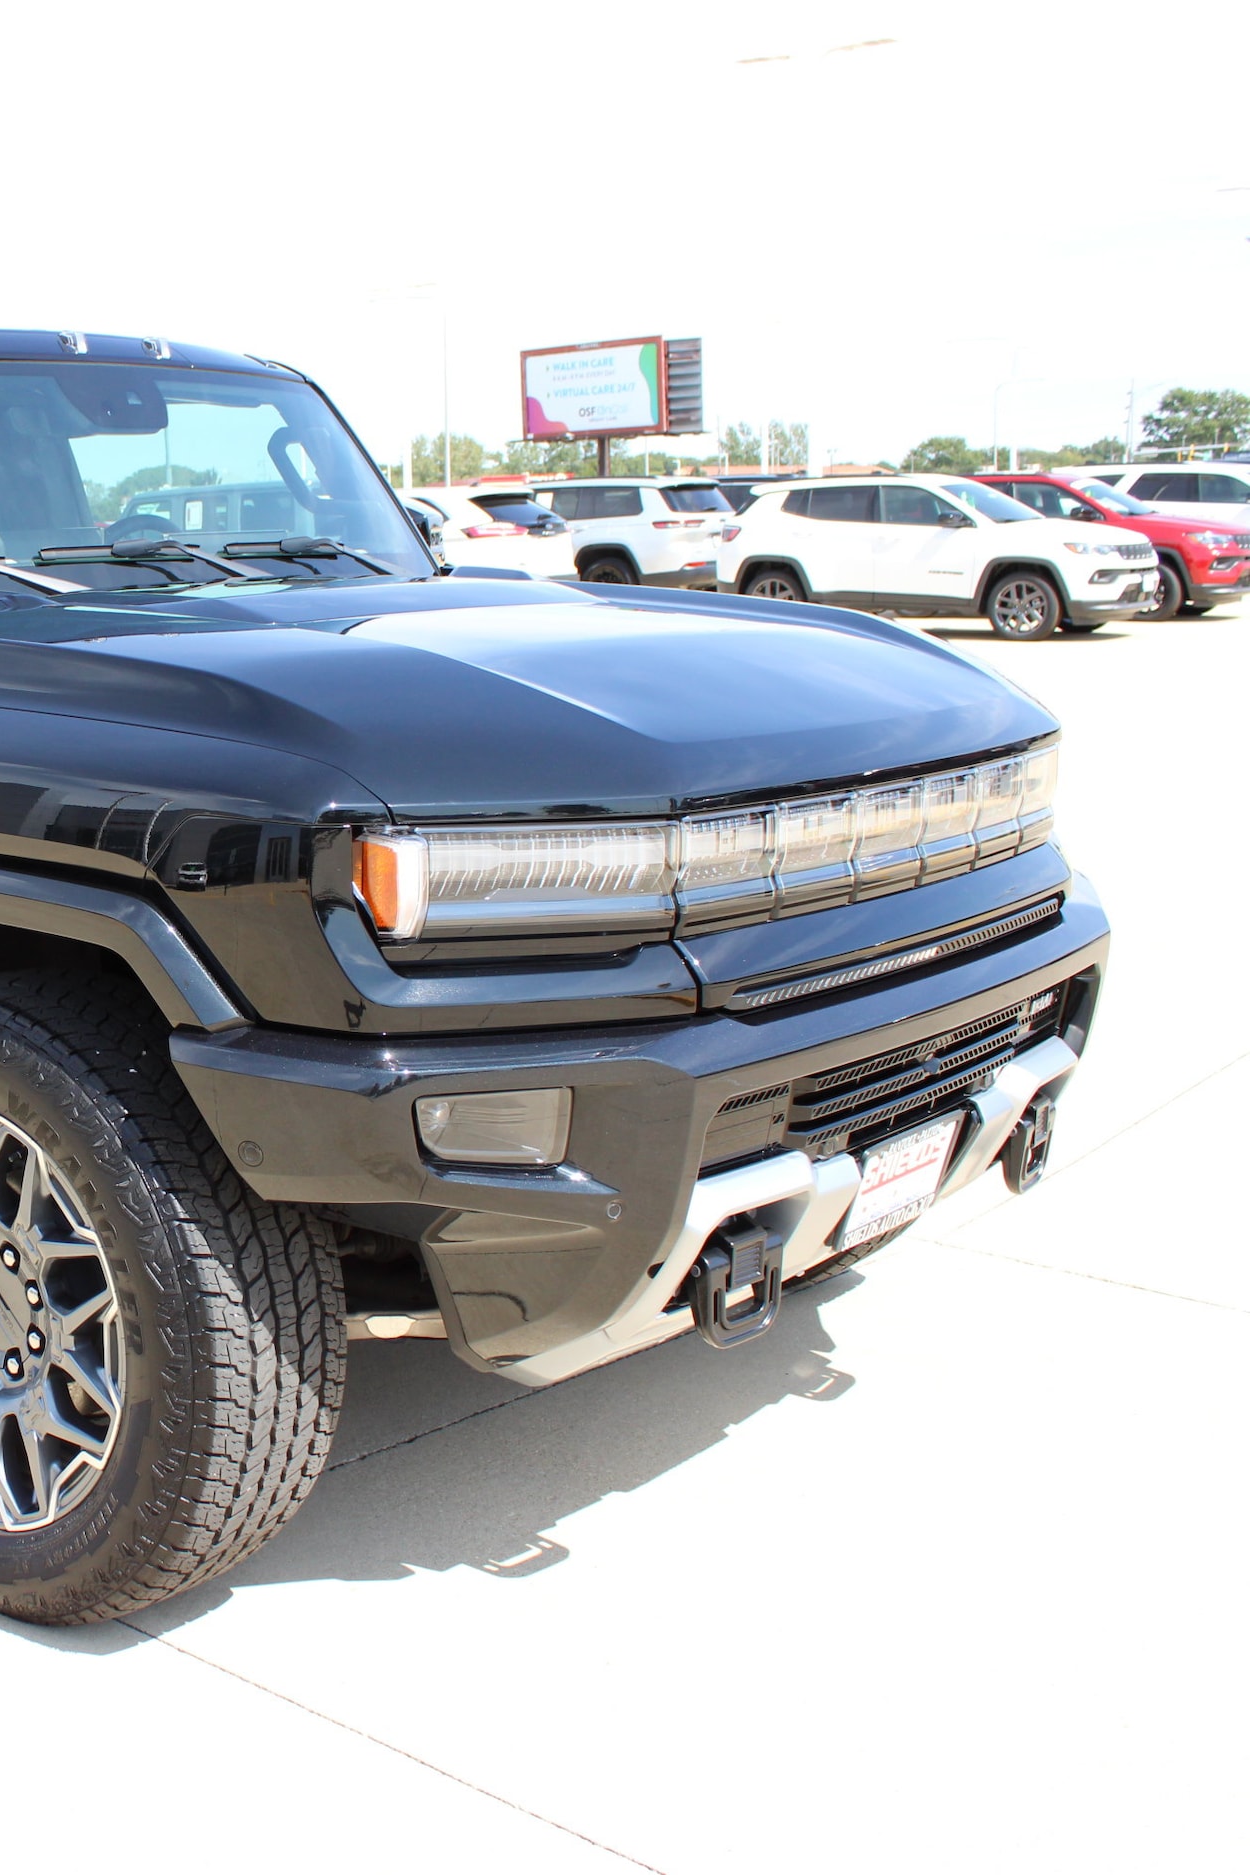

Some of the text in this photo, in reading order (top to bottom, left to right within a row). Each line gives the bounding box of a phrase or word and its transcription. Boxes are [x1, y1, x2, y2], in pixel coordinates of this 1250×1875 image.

[553, 357, 615, 371] WALK IN CARE
[553, 382, 636, 398] VIRTUAL CARE 24/7
[578, 406, 596, 417] OSF
[7, 1089, 145, 1356] WRANGLER
